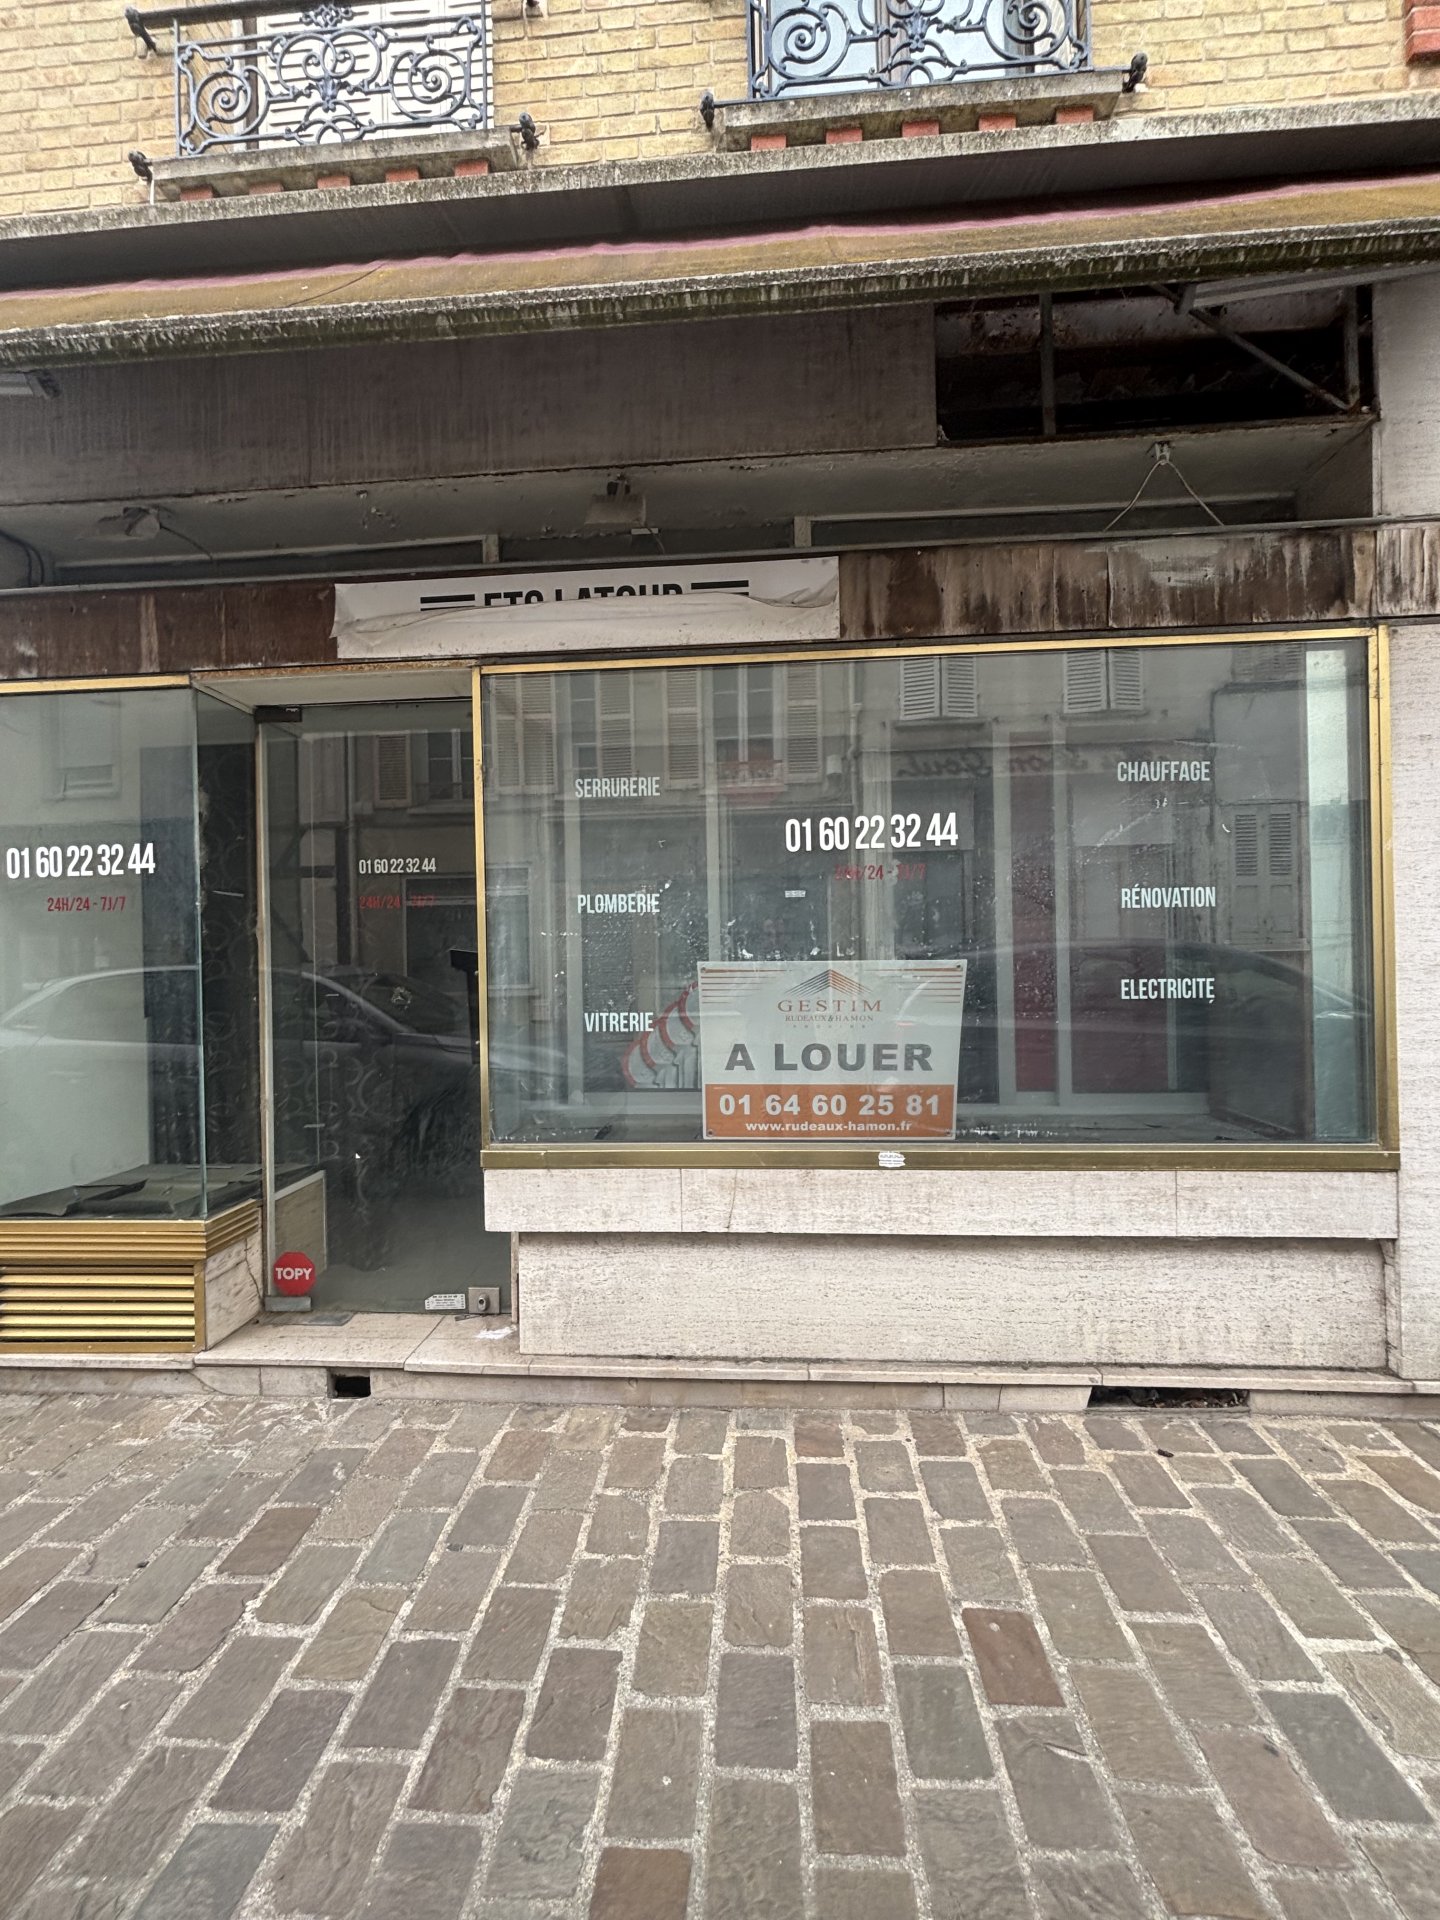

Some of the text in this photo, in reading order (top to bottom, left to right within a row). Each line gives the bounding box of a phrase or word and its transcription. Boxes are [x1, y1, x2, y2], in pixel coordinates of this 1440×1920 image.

[1117, 761, 1210, 782] CHAUFFAGE
[575, 776, 660, 799] SERRURERIE
[785, 812, 958, 853] 01 60 22 32 44
[6, 842, 156, 879] 01 60 22 32 44
[359, 857, 436, 874] 01 60 22 32 44
[47, 897, 90, 912] 24H/24
[101, 896, 126, 911] 7J/7
[577, 893, 661, 914] PLOMBERIE
[1121, 883, 1216, 909] RÉNOVATION
[777, 999, 882, 1013] GESTIM
[584, 1012, 654, 1033] VITRERIE
[724, 1043, 933, 1072] A LOUER
[719, 1094, 939, 1116] 01 64 60 25 81
[745, 1120, 913, 1132] www.rudeaux-hamon.fr
[275, 1267, 312, 1280] TOPY
